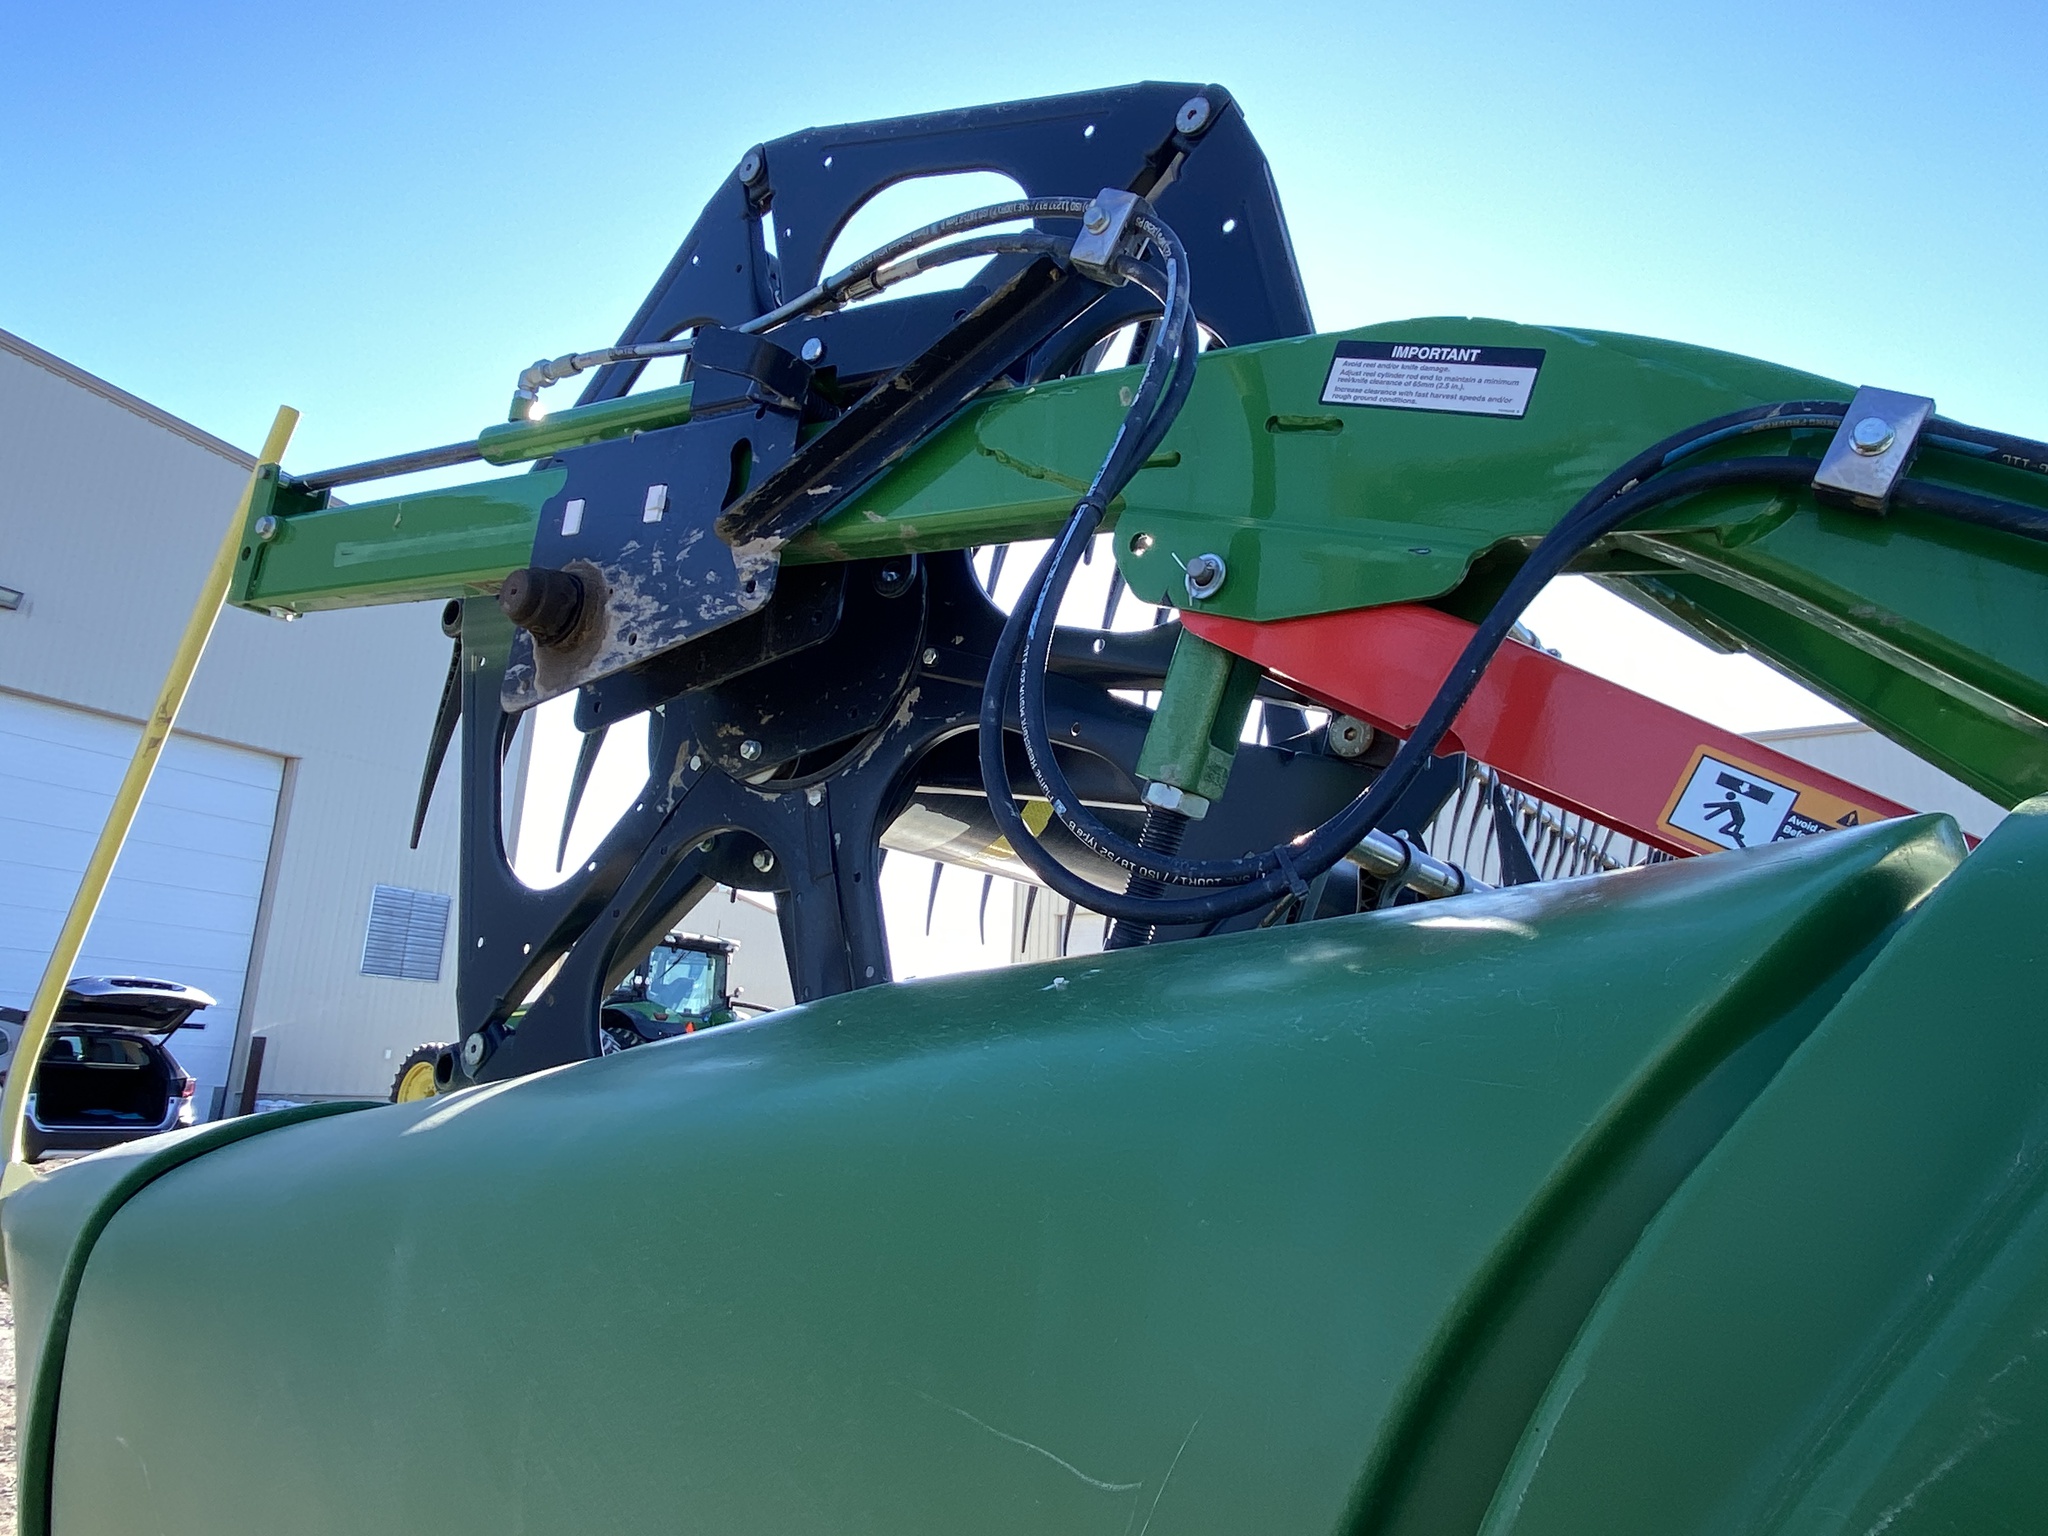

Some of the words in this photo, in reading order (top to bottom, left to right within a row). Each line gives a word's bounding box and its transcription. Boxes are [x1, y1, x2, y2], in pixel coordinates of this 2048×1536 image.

[1069, 201, 1082, 212] ISO
[1391, 346, 1481, 362] IMPORTANT
[1342, 360, 1362, 368] Avoid
[1401, 363, 1418, 371] knife
[1420, 364, 1450, 373] damage.
[1340, 369, 1361, 377] Adjust
[1377, 371, 1405, 379] cylinder
[1420, 373, 1434, 381] end
[1444, 375, 1476, 383] maintain
[1484, 378, 1520, 386] minimum
[1369, 378, 1402, 386] clearance
[1404, 379, 1411, 387] of
[1413, 380, 1434, 388] 65mm
[1435, 381, 1449, 390] (2.5
[1332, 393, 1351, 401] rough
[1353, 394, 1377, 402] ground
[1378, 396, 1418, 405] conditions.
[1334, 386, 1363, 394] Increase
[1364, 387, 1397, 395] clearance
[1399, 388, 1413, 397] with
[1414, 389, 1429, 397] fast
[1430, 391, 1457, 399] harvest
[1458, 394, 1486, 402] speeds
[1487, 395, 1513, 404] and/or
[1788, 815, 1818, 832] Avoid
